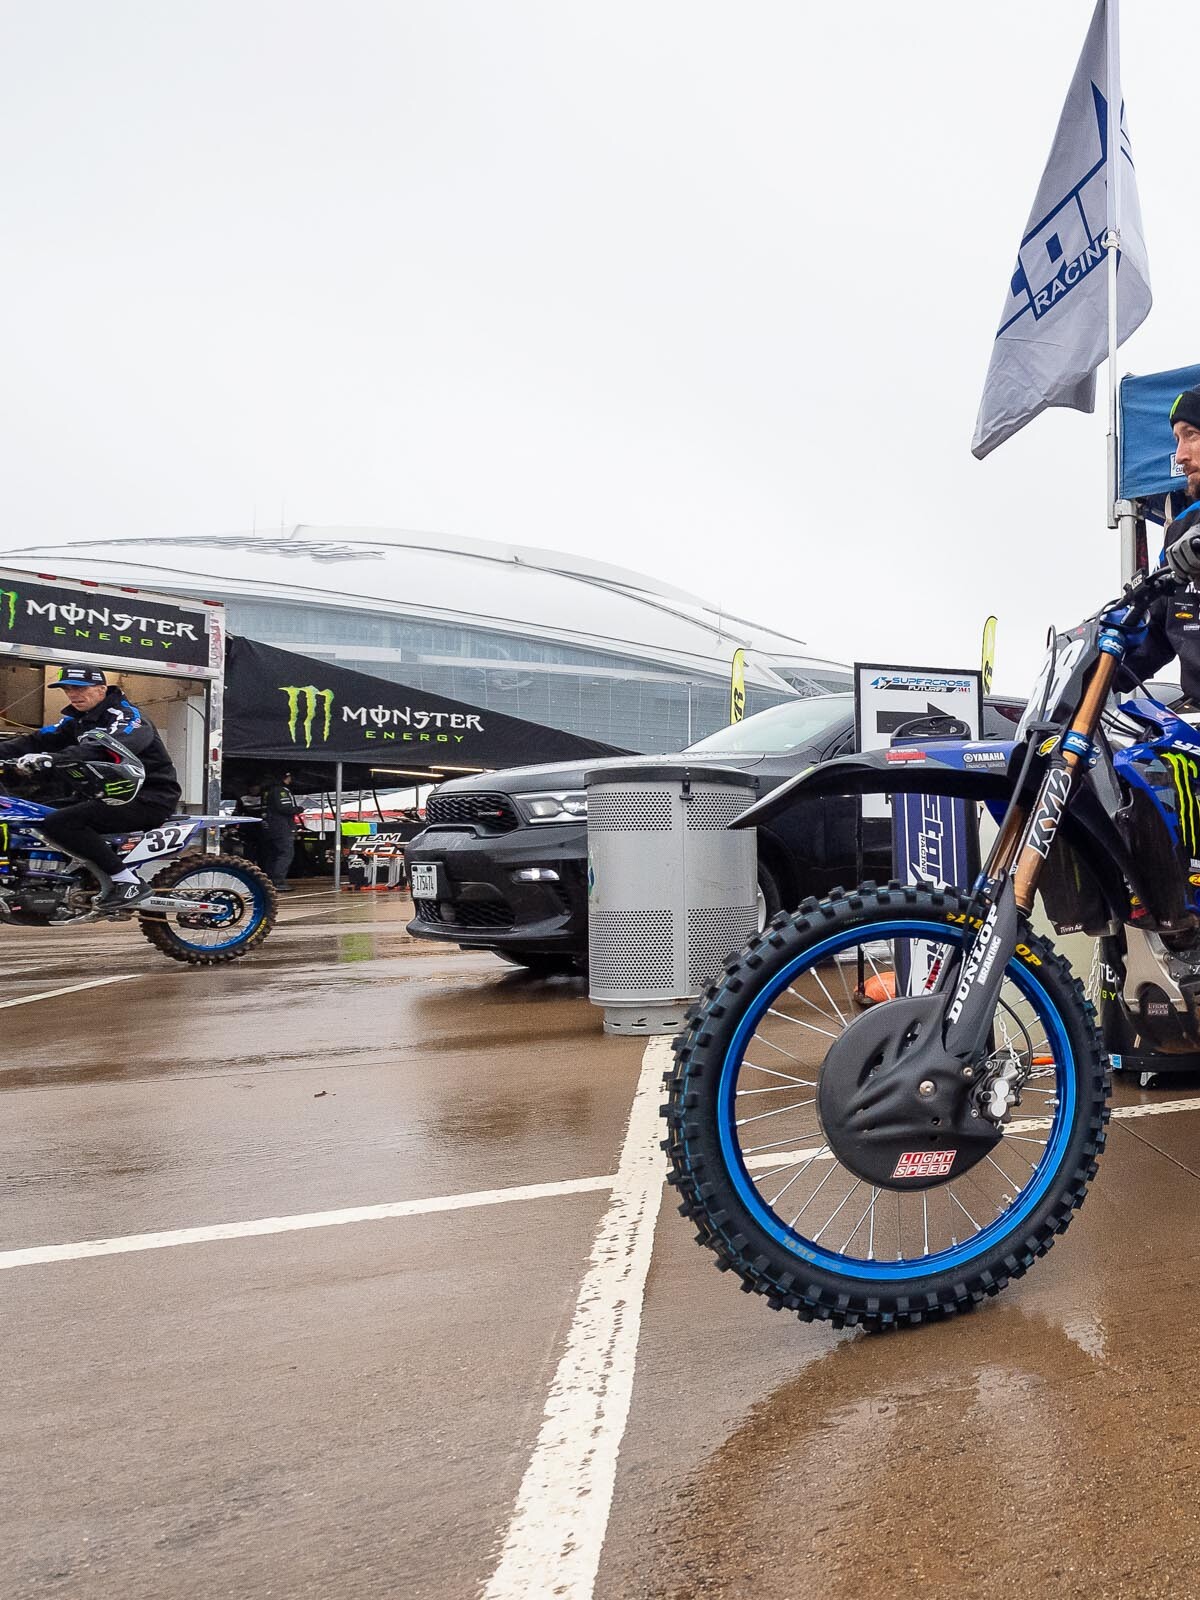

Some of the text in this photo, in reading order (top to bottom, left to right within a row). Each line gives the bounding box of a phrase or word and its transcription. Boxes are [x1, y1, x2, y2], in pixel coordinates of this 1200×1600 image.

[26, 599, 198, 641] MONSTER
[53, 626, 173, 649] ENERGY
[892, 677, 971, 687] SUPERCROSS
[341, 705, 485, 732] MONSTER
[365, 730, 464, 743] ENERGY
[973, 752, 1006, 762] YAMAHA
[1025, 768, 1072, 860] KYB
[145, 828, 185, 853] 32
[920, 834, 928, 875] RACING
[949, 902, 998, 1025] DUNLOP
[977, 935, 1002, 986] BRAKING
[895, 1163, 949, 1176] SPEED
[900, 1151, 955, 1164] LIGHT
